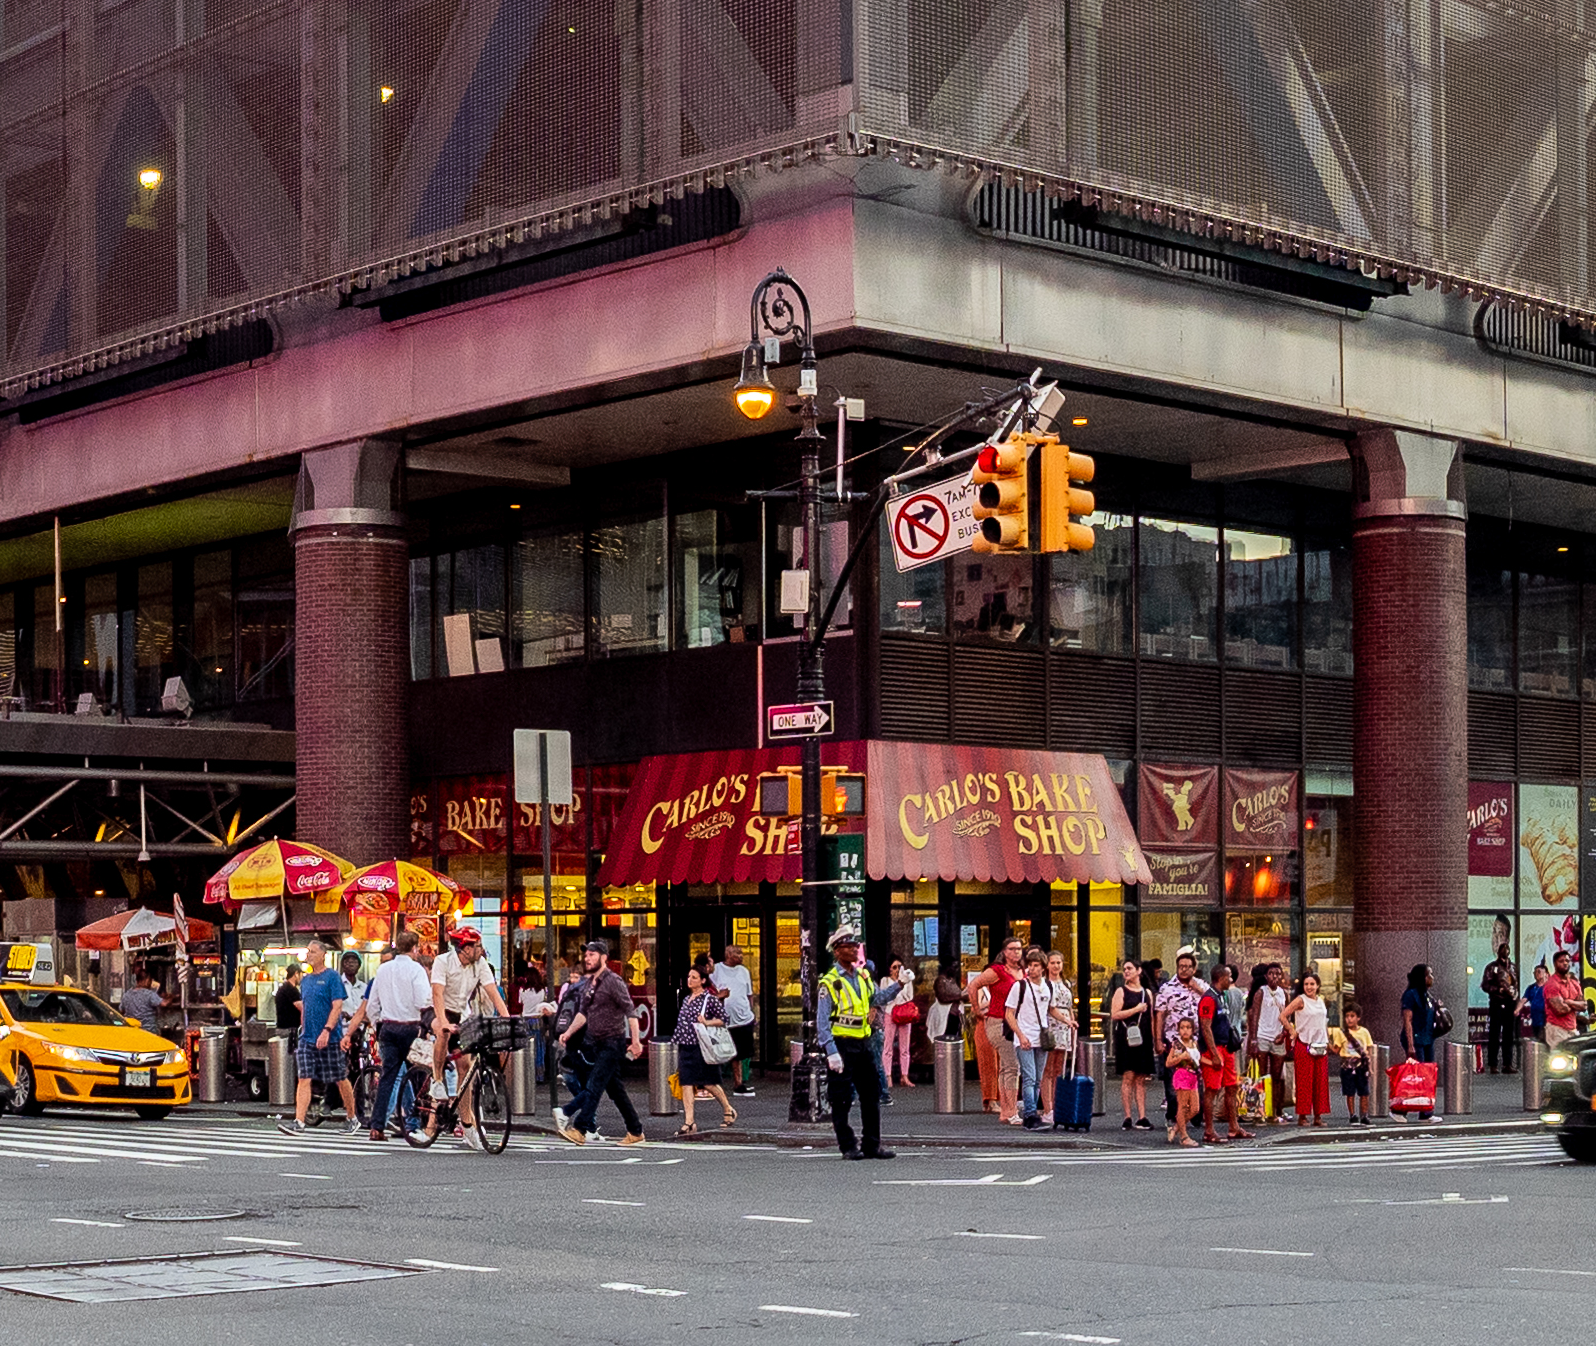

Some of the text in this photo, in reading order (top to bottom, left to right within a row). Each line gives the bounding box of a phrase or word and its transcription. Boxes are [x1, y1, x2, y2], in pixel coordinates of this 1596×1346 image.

[945, 484, 983, 505] 7AM-7
[952, 506, 972, 522] EXC
[958, 522, 983, 539] BUS
[778, 713, 823, 727] ONE WAY
[899, 771, 1098, 850] CARLO'S BAKE
[1232, 785, 1289, 832] CARLO'S
[1549, 798, 1577, 809] DAILY
[446, 797, 503, 830] BAKE
[641, 774, 749, 854] CARLO'S
[956, 809, 1001, 829] SINCE 1910
[690, 815, 718, 834] SINCE
[1013, 815, 1107, 855] SHOP
[1148, 883, 1208, 895] FAMIGLIA!
[839, 1015, 855, 1025] NY
